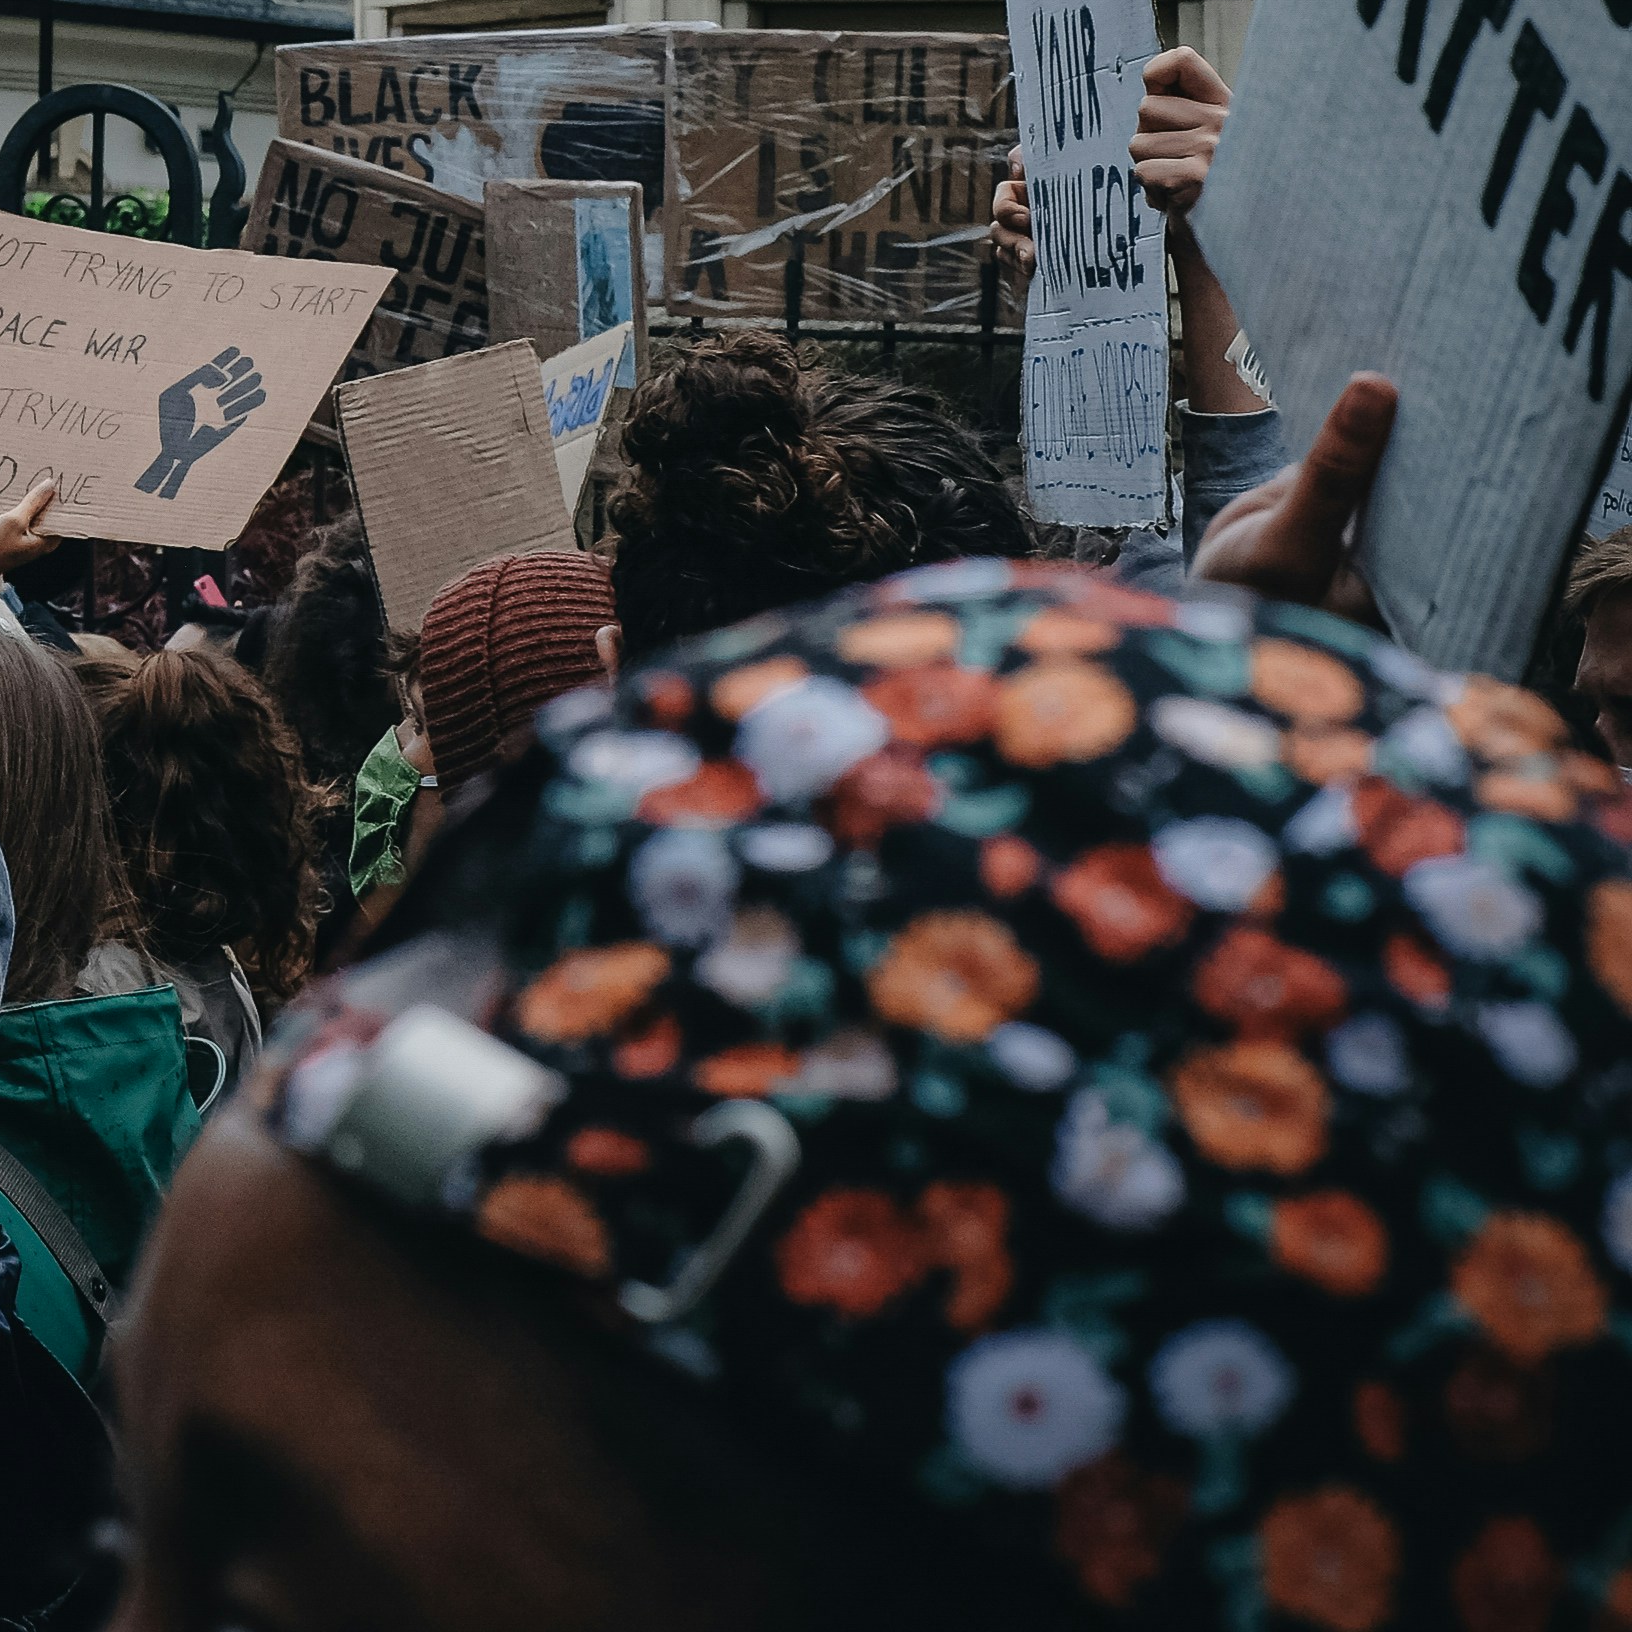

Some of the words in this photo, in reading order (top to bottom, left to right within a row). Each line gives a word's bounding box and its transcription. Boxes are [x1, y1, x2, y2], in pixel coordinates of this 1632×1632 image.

[299, 63, 485, 127] BLACK
[1032, 3, 1102, 157] YOUR
[268, 159, 359, 249] NO
[379, 202, 486, 285] JU
[1032, 164, 1145, 313] PRIVILEGE
[61, 248, 174, 301] TRYING
[203, 271, 246, 303] TO
[260, 282, 371, 318] START
[0, 386, 122, 442] TRYING
[26, 466, 103, 507] ONE
